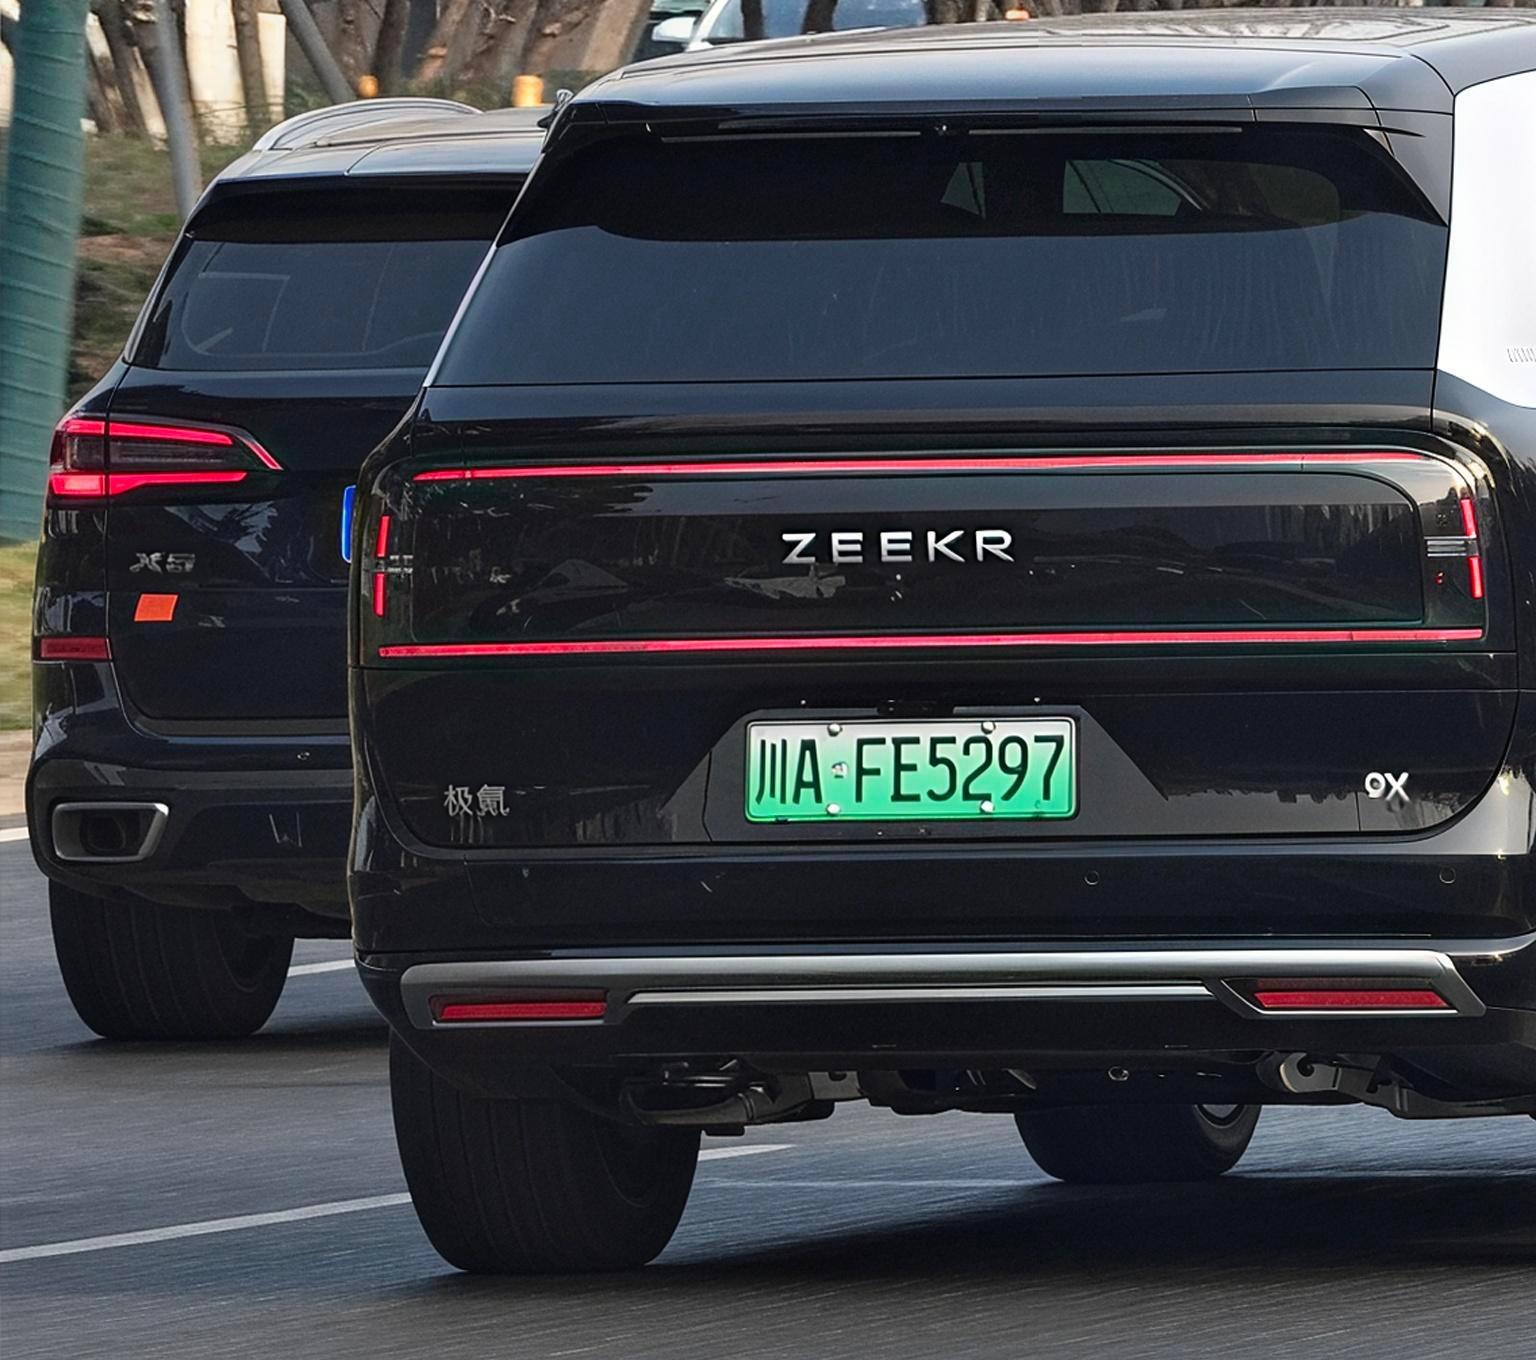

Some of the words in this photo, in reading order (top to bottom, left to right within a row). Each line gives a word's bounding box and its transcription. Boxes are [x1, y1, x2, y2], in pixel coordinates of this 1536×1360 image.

[782, 529, 1014, 564] ZEEKR
[443, 784, 510, 817] 极氪
[1364, 771, 1410, 801] 9X
